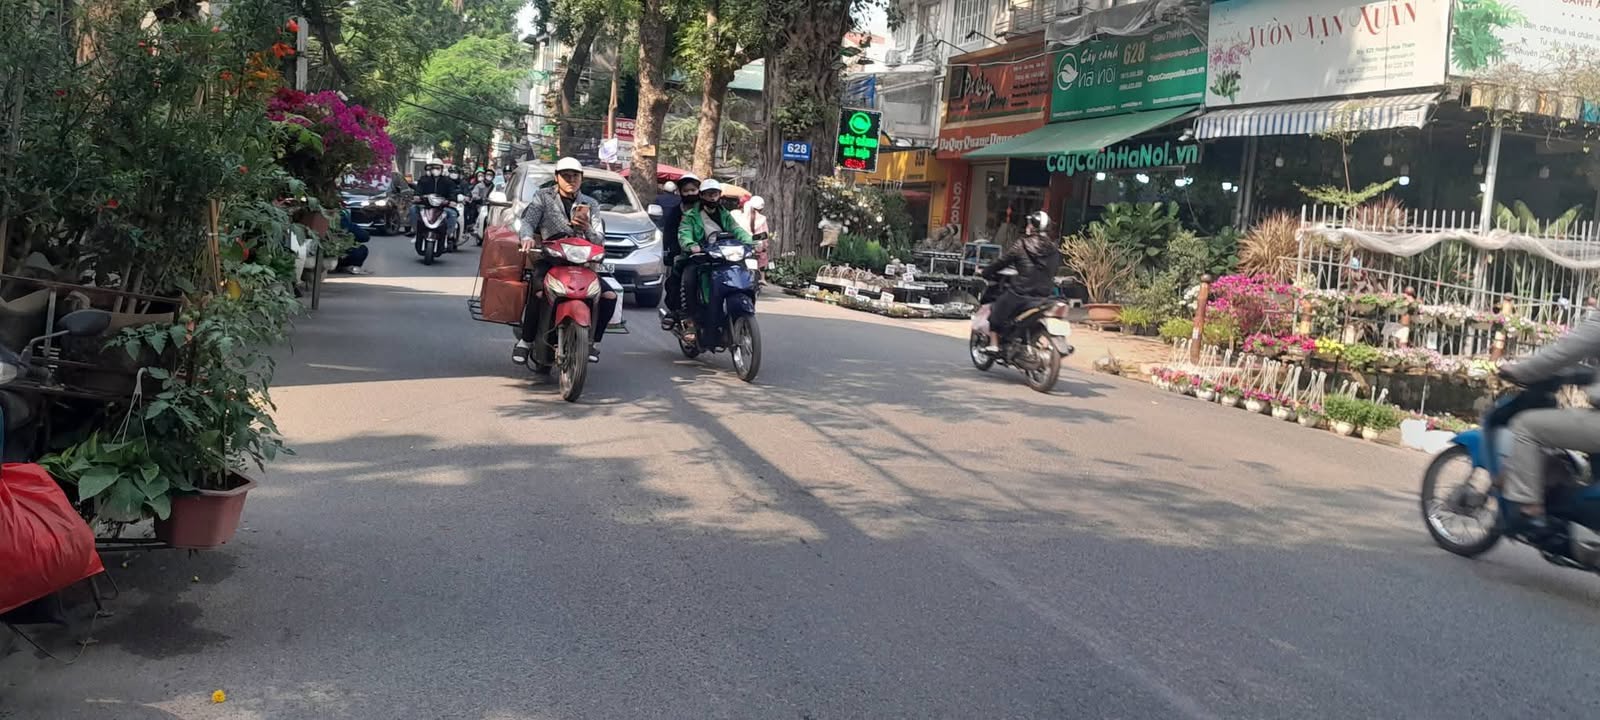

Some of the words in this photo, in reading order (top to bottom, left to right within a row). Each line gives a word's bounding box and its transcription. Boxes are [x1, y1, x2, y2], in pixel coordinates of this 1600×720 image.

[1123, 41, 1146, 65] 628
[787, 143, 807, 154] 628
[950, 181, 962, 224] 628
